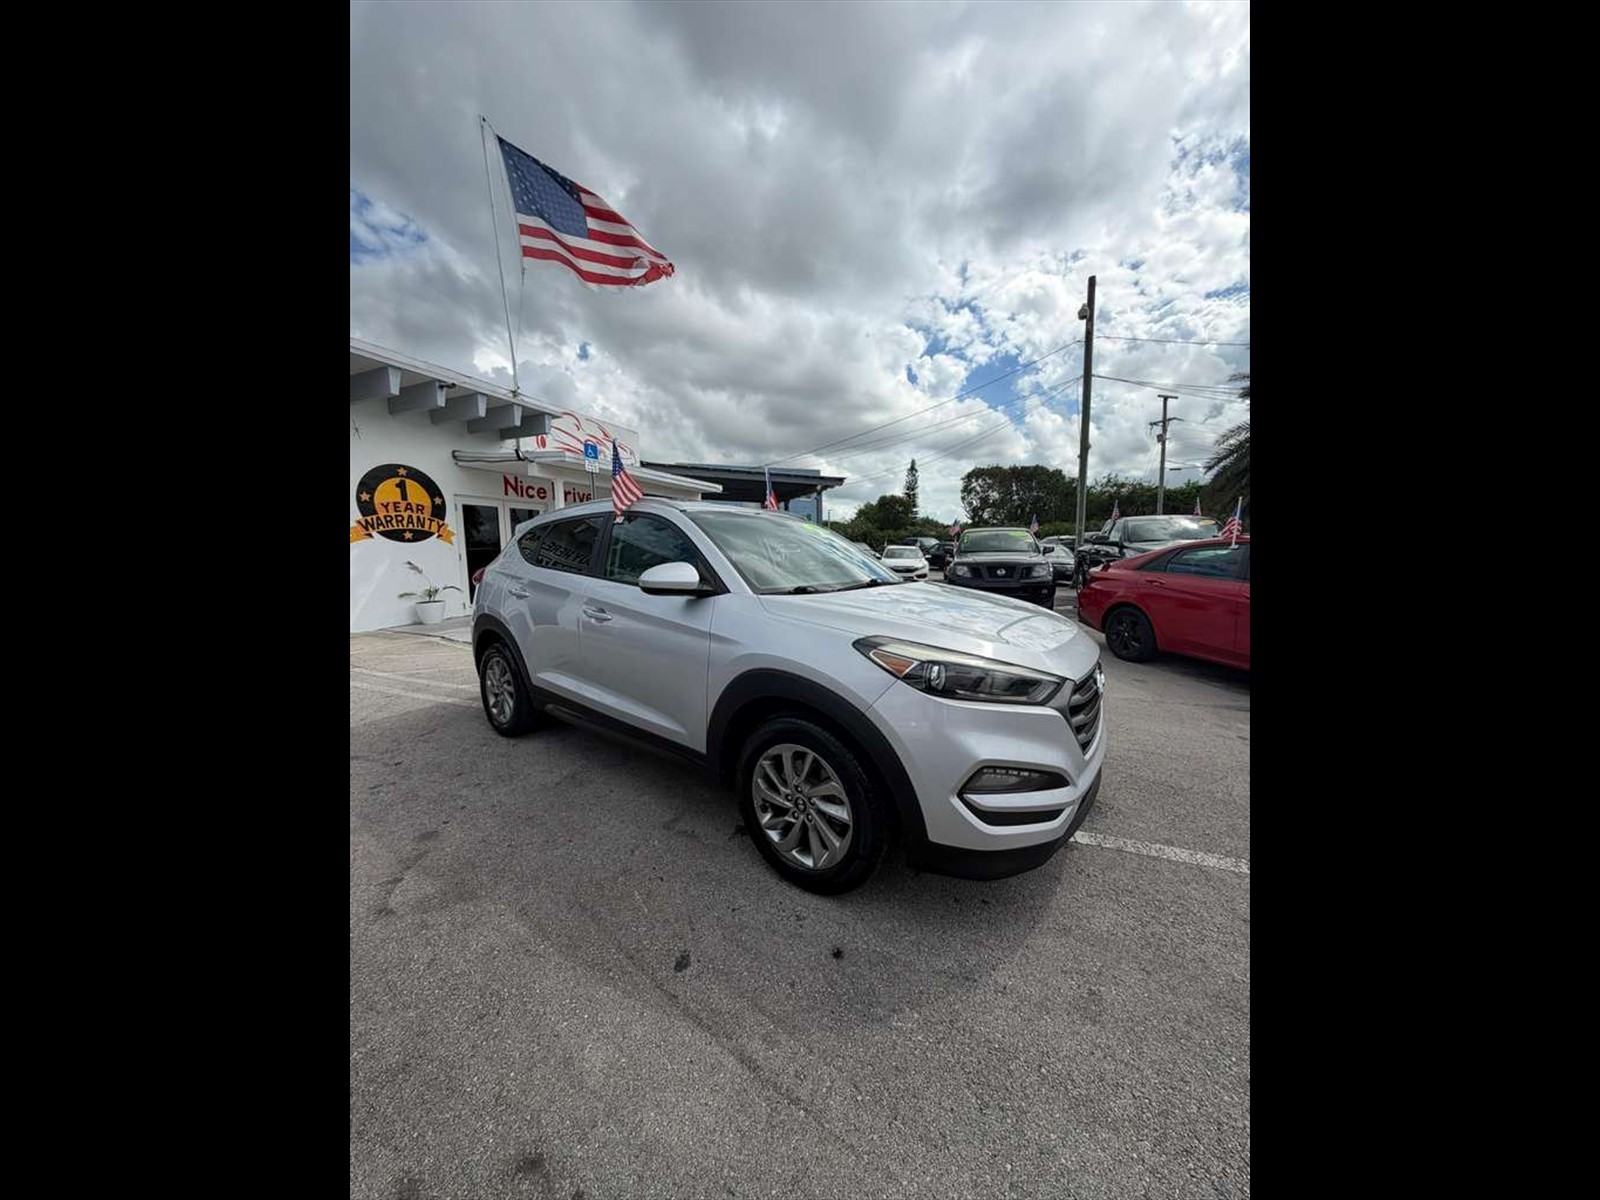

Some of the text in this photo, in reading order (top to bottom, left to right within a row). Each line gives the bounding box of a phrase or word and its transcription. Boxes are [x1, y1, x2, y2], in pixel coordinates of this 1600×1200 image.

[395, 479, 408, 501] 1
[503, 474, 592, 503] Nice rive
[380, 501, 425, 515] YEAR
[357, 515, 445, 532] WARRANTY
